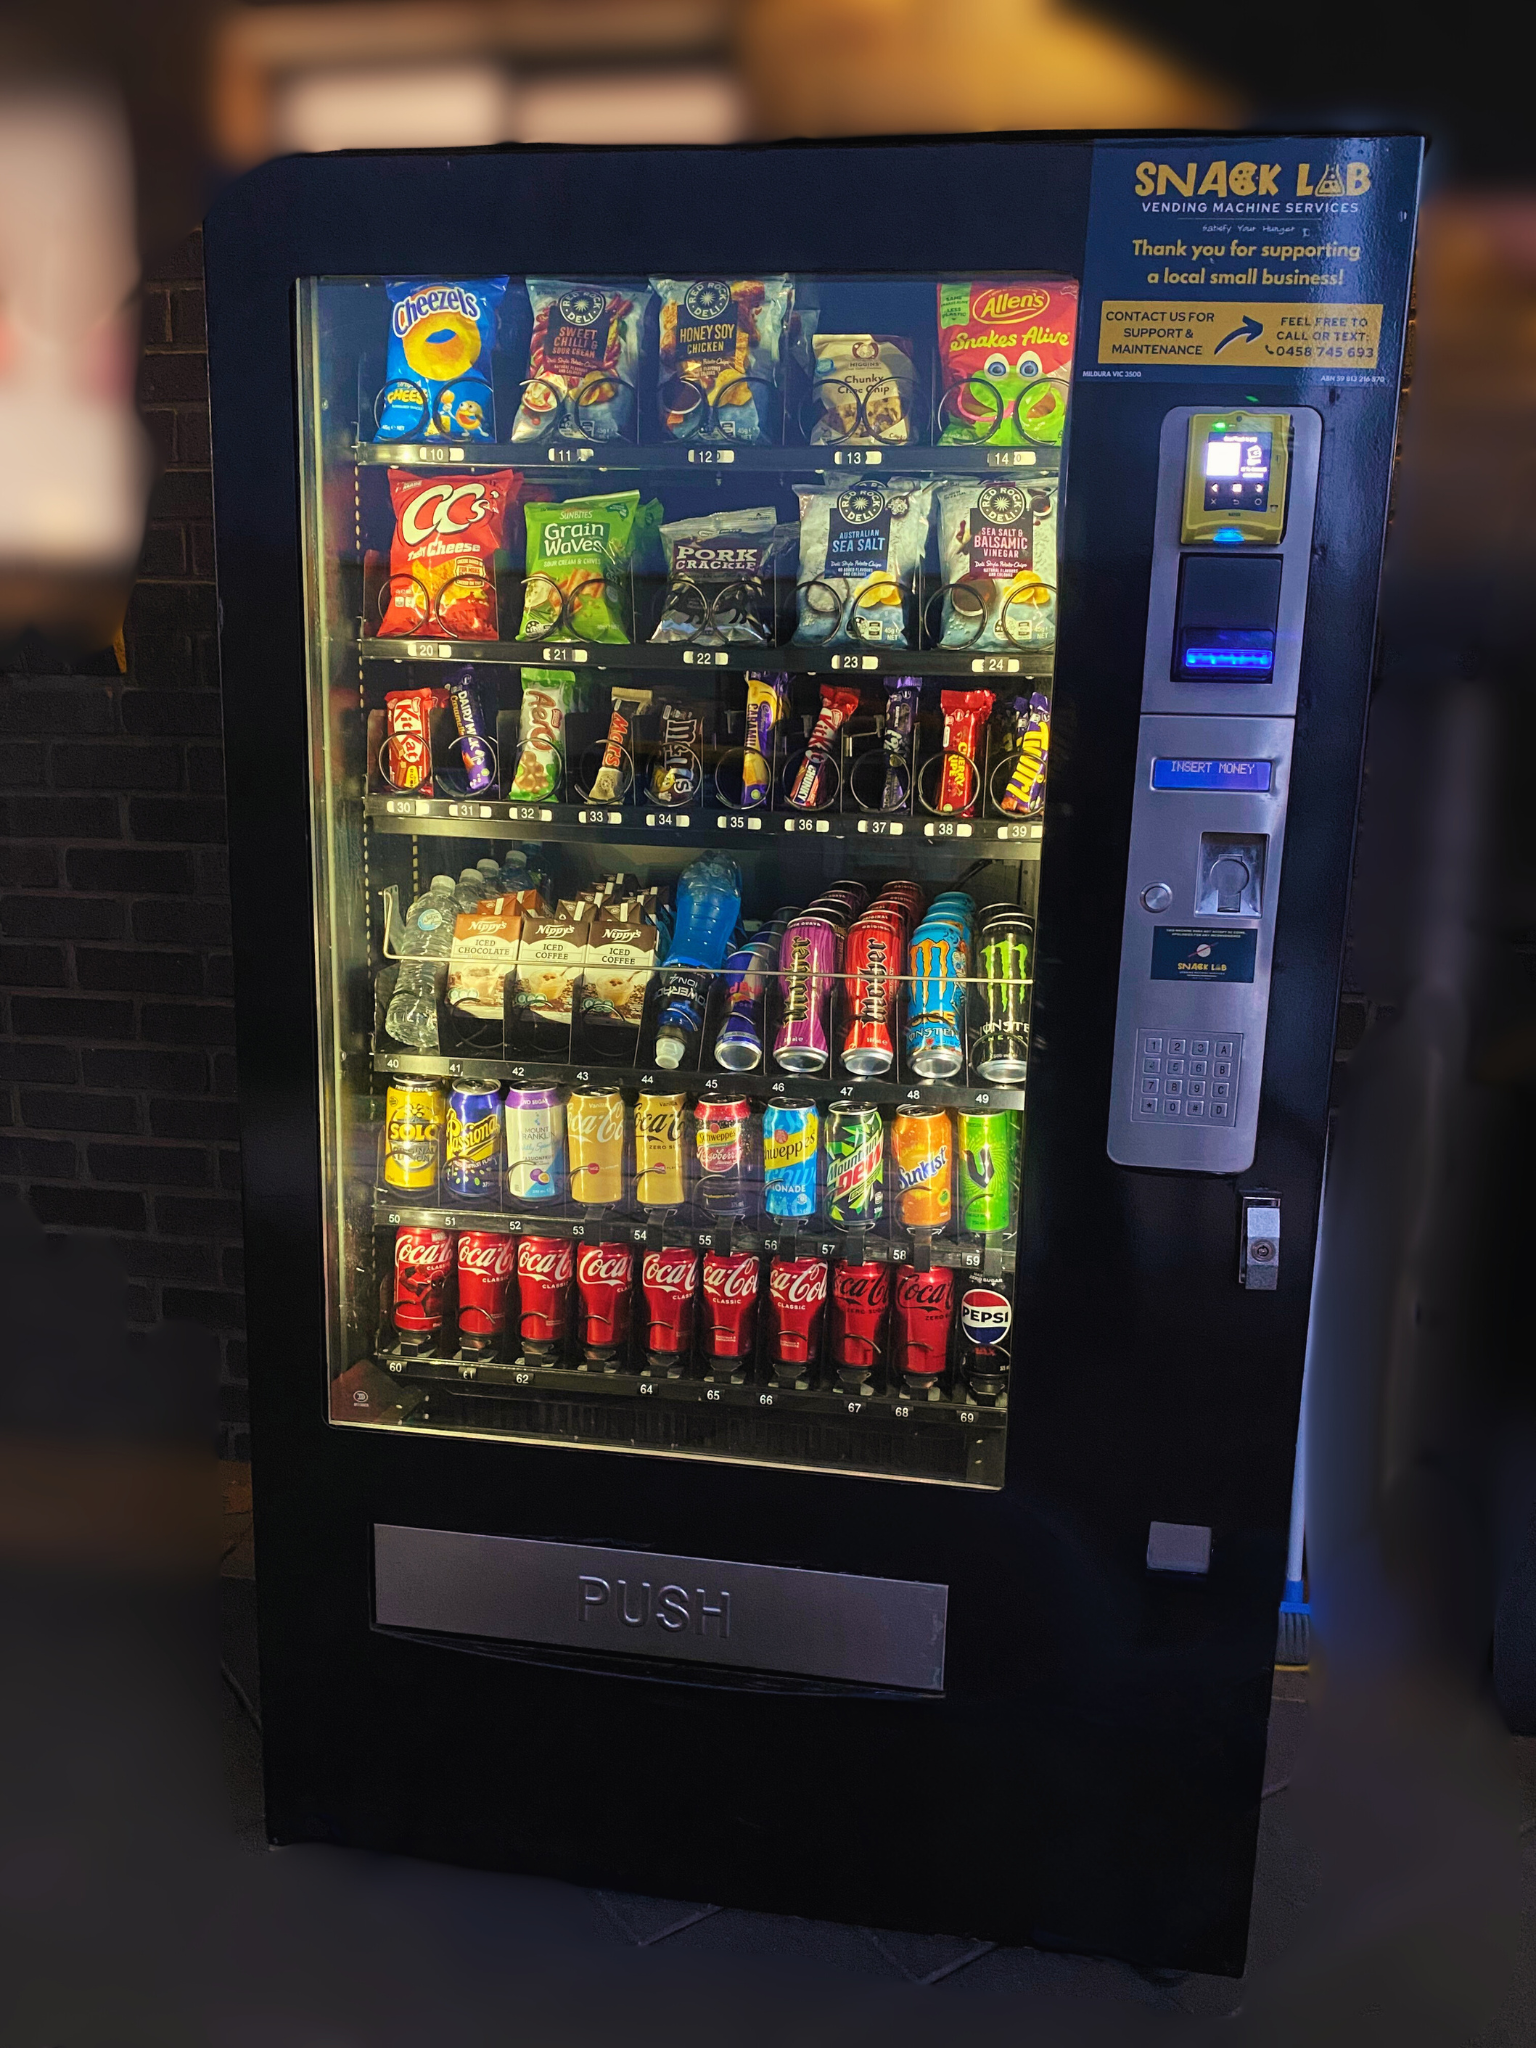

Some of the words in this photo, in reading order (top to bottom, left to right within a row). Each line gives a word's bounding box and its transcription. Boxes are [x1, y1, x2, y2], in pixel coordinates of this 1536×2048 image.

[1135, 160, 1281, 197] SNACK
[1142, 202, 1208, 213] VENDING
[1213, 203, 1280, 213] MACHINE
[1285, 203, 1359, 213] SERVICES
[1202, 224, 1231, 234] Satisfy
[1263, 225, 1295, 235] Hunger
[1132, 240, 1186, 257] Thank
[1192, 243, 1225, 260] you
[1230, 240, 1256, 257] for
[1261, 241, 1360, 262] supporting
[1147, 271, 1159, 284] a
[1164, 268, 1205, 284] local
[1210, 269, 1257, 285] small
[1262, 269, 1343, 285] business!
[981, 293, 1044, 318] Allen's
[393, 287, 480, 338] Cheezels
[567, 310, 594, 324] DELI
[693, 307, 721, 317] DELI
[1106, 311, 1166, 322] CONTACT
[1169, 312, 1185, 322] US
[1188, 312, 1215, 322] FOR
[1281, 317, 1311, 326] FEEL
[1315, 318, 1347, 327] FREE
[1351, 318, 1368, 327] TO
[559, 327, 597, 339] SWEET
[680, 325, 712, 343] HONEY
[715, 324, 735, 339] SOY
[950, 330, 1017, 352] Snakes
[1022, 326, 1069, 346] Alive
[1123, 328, 1181, 338] SUPPORT
[1185, 329, 1193, 338] &
[1277, 331, 1308, 340] CALL
[1312, 331, 1330, 341] OR
[1334, 332, 1369, 341] TEXT:
[554, 338, 587, 348] CHILLI
[687, 342, 724, 354] CHICKEN
[572, 348, 595, 358] CREAM
[1112, 345, 1202, 355] MAINTENANCE
[1277, 346, 1312, 357] 0458
[1317, 347, 1343, 357] 745
[1347, 347, 1373, 357] 693
[845, 374, 884, 386] Chunky
[430, 449, 443, 461] 10
[559, 450, 571, 461] 11
[699, 451, 712, 463] 12
[847, 452, 861, 463] 13
[995, 453, 1009, 464] 14
[847, 510, 874, 521] DELI
[987, 511, 1015, 522] DELI
[544, 523, 604, 539] Grain
[839, 529, 880, 539] AUSTRALIAN
[981, 527, 996, 536] SEA
[999, 528, 1016, 536] SALT
[427, 541, 481, 556] Cheese
[544, 537, 602, 556] Waves
[832, 539, 854, 553] SEA
[857, 537, 885, 551] SALT
[974, 536, 1028, 549] BALSAMIC
[676, 546, 758, 562] PORK
[983, 549, 1019, 558] VINEGAR
[544, 559, 558, 567] SOUR
[676, 560, 756, 571] CRACKLE
[420, 645, 433, 656] 20
[554, 649, 566, 660] 21
[697, 653, 711, 664] 22
[843, 657, 858, 668] 23
[988, 659, 1003, 671] 24
[457, 690, 473, 724] DAIRY
[602, 711, 629, 767] Mars
[1171, 761, 1212, 773] INSERT
[1219, 763, 1254, 774] MONEY
[798, 764, 817, 801] CHUNKY
[397, 802, 411, 813] 30
[461, 805, 474, 815] 31
[521, 809, 534, 819] 32
[590, 812, 603, 822] 33
[659, 814, 672, 825] 34
[730, 817, 744, 828] 35
[799, 820, 812, 830] 36
[872, 822, 886, 833] 37
[938, 825, 953, 835] 38
[1012, 826, 1027, 837] 39
[468, 920, 507, 934] Nippy's
[535, 924, 575, 939] Nippy's
[602, 929, 641, 943] Nippy's
[458, 947, 510, 955] CHOCOLATE
[535, 951, 569, 960] COFFEE
[609, 948, 631, 956] ICED
[601, 956, 636, 965] COFFEE
[387, 1059, 399, 1068] 40
[450, 1064, 461, 1072] 41
[512, 1068, 524, 1077] 42
[576, 1072, 589, 1080] 43
[641, 1075, 653, 1083] 44
[706, 1080, 718, 1088] 45
[772, 1083, 784, 1091] 46
[840, 1086, 854, 1096] 47
[907, 1090, 920, 1100] 48
[976, 1094, 989, 1104] 49
[898, 1146, 947, 1190] Sunkist
[389, 1214, 400, 1223] 50
[445, 1217, 456, 1225] 51
[510, 1222, 521, 1230] 52
[573, 1226, 584, 1234] 53
[634, 1230, 647, 1240] 54
[699, 1235, 711, 1245] 55
[765, 1240, 777, 1250] 56
[822, 1245, 835, 1254] 57
[893, 1250, 906, 1260] 58
[966, 1255, 980, 1266] 59
[778, 1302, 806, 1310] CLASSIC
[963, 1306, 1009, 1324] PEPSI
[389, 1362, 402, 1372] 60
[516, 1374, 528, 1384] 62
[640, 1384, 653, 1394] 64
[707, 1390, 720, 1400] 65
[760, 1395, 773, 1405] 66
[848, 1404, 861, 1413] 67
[895, 1407, 909, 1417] 68
[961, 1413, 974, 1423] 69
[577, 1575, 731, 1639] PUSH
